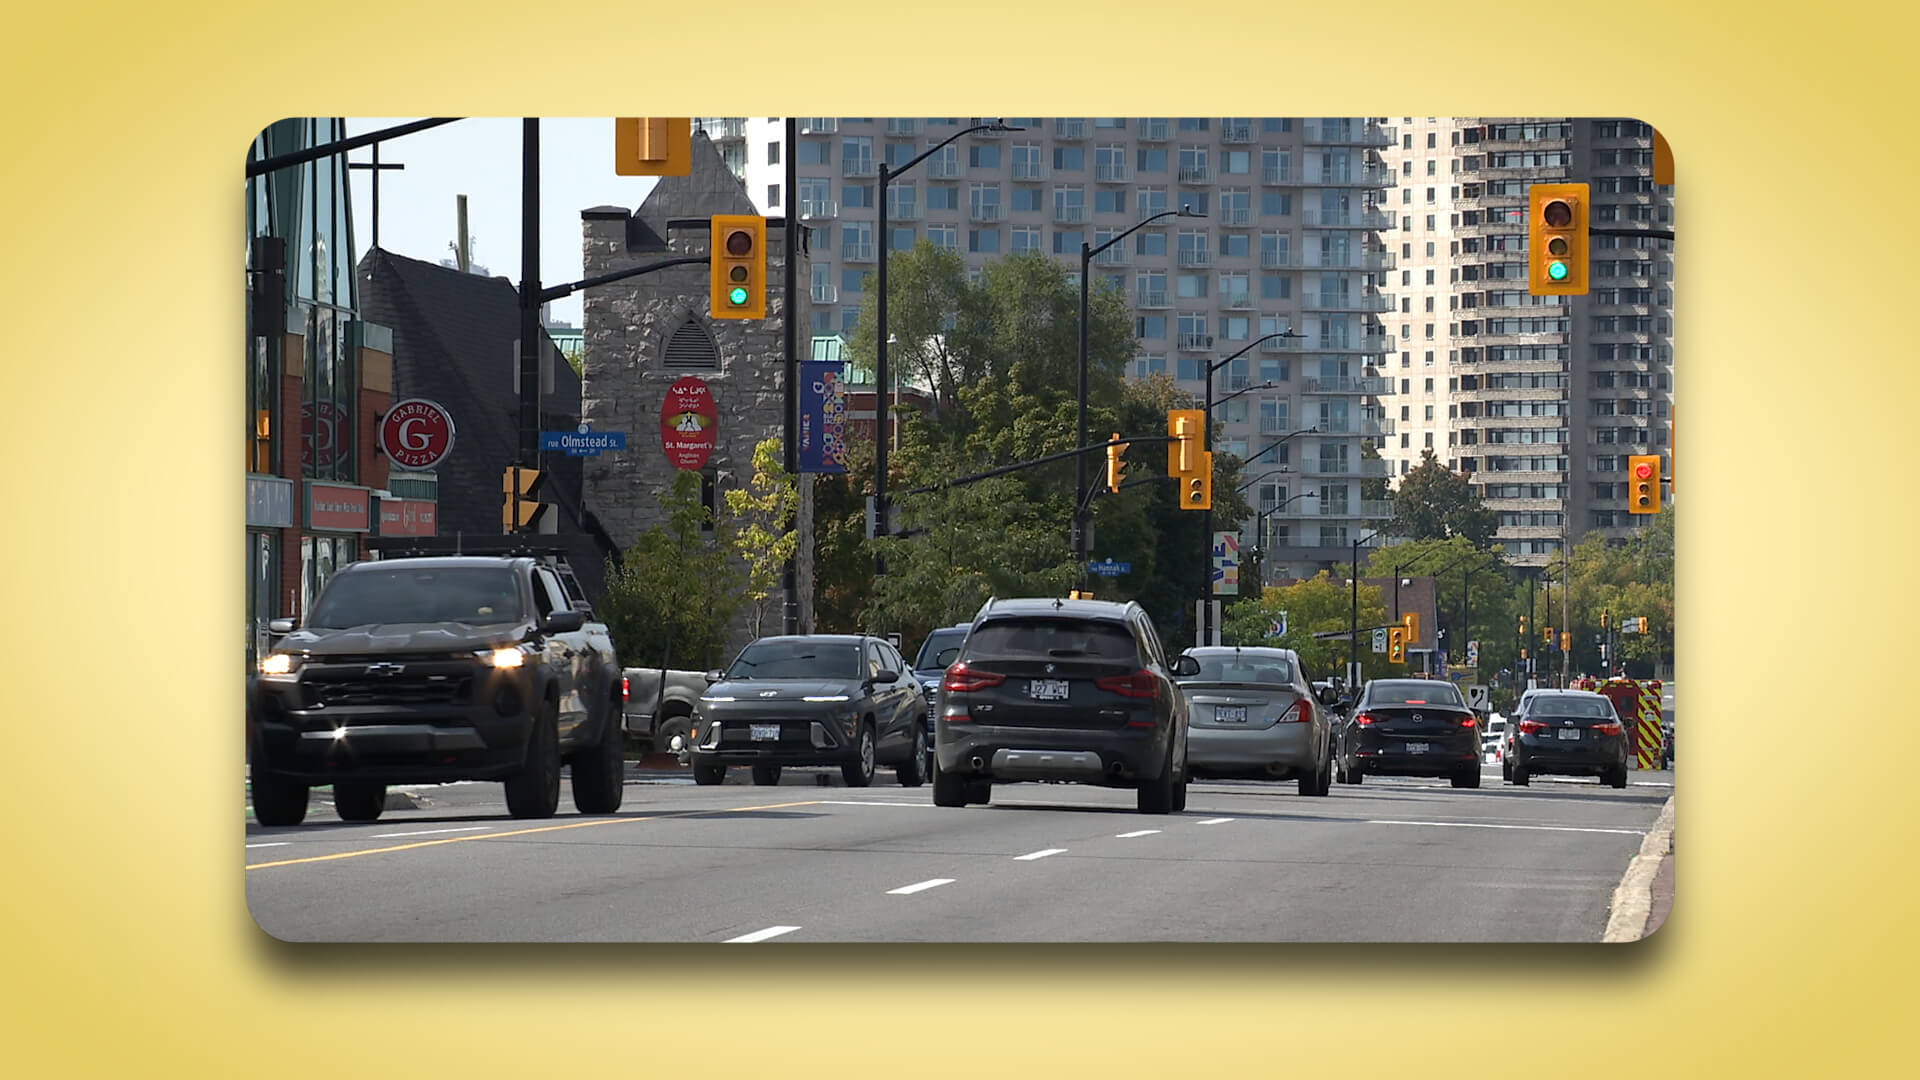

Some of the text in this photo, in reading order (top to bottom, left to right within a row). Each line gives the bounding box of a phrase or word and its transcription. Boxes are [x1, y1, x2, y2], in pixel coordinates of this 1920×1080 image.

[392, 405, 440, 424] GABRIEL
[398, 417, 434, 451] G
[547, 440, 559, 448] rue
[561, 434, 608, 448] Olmstead
[665, 441, 713, 450] St. Margaret's
[395, 449, 438, 465] PIZZA
